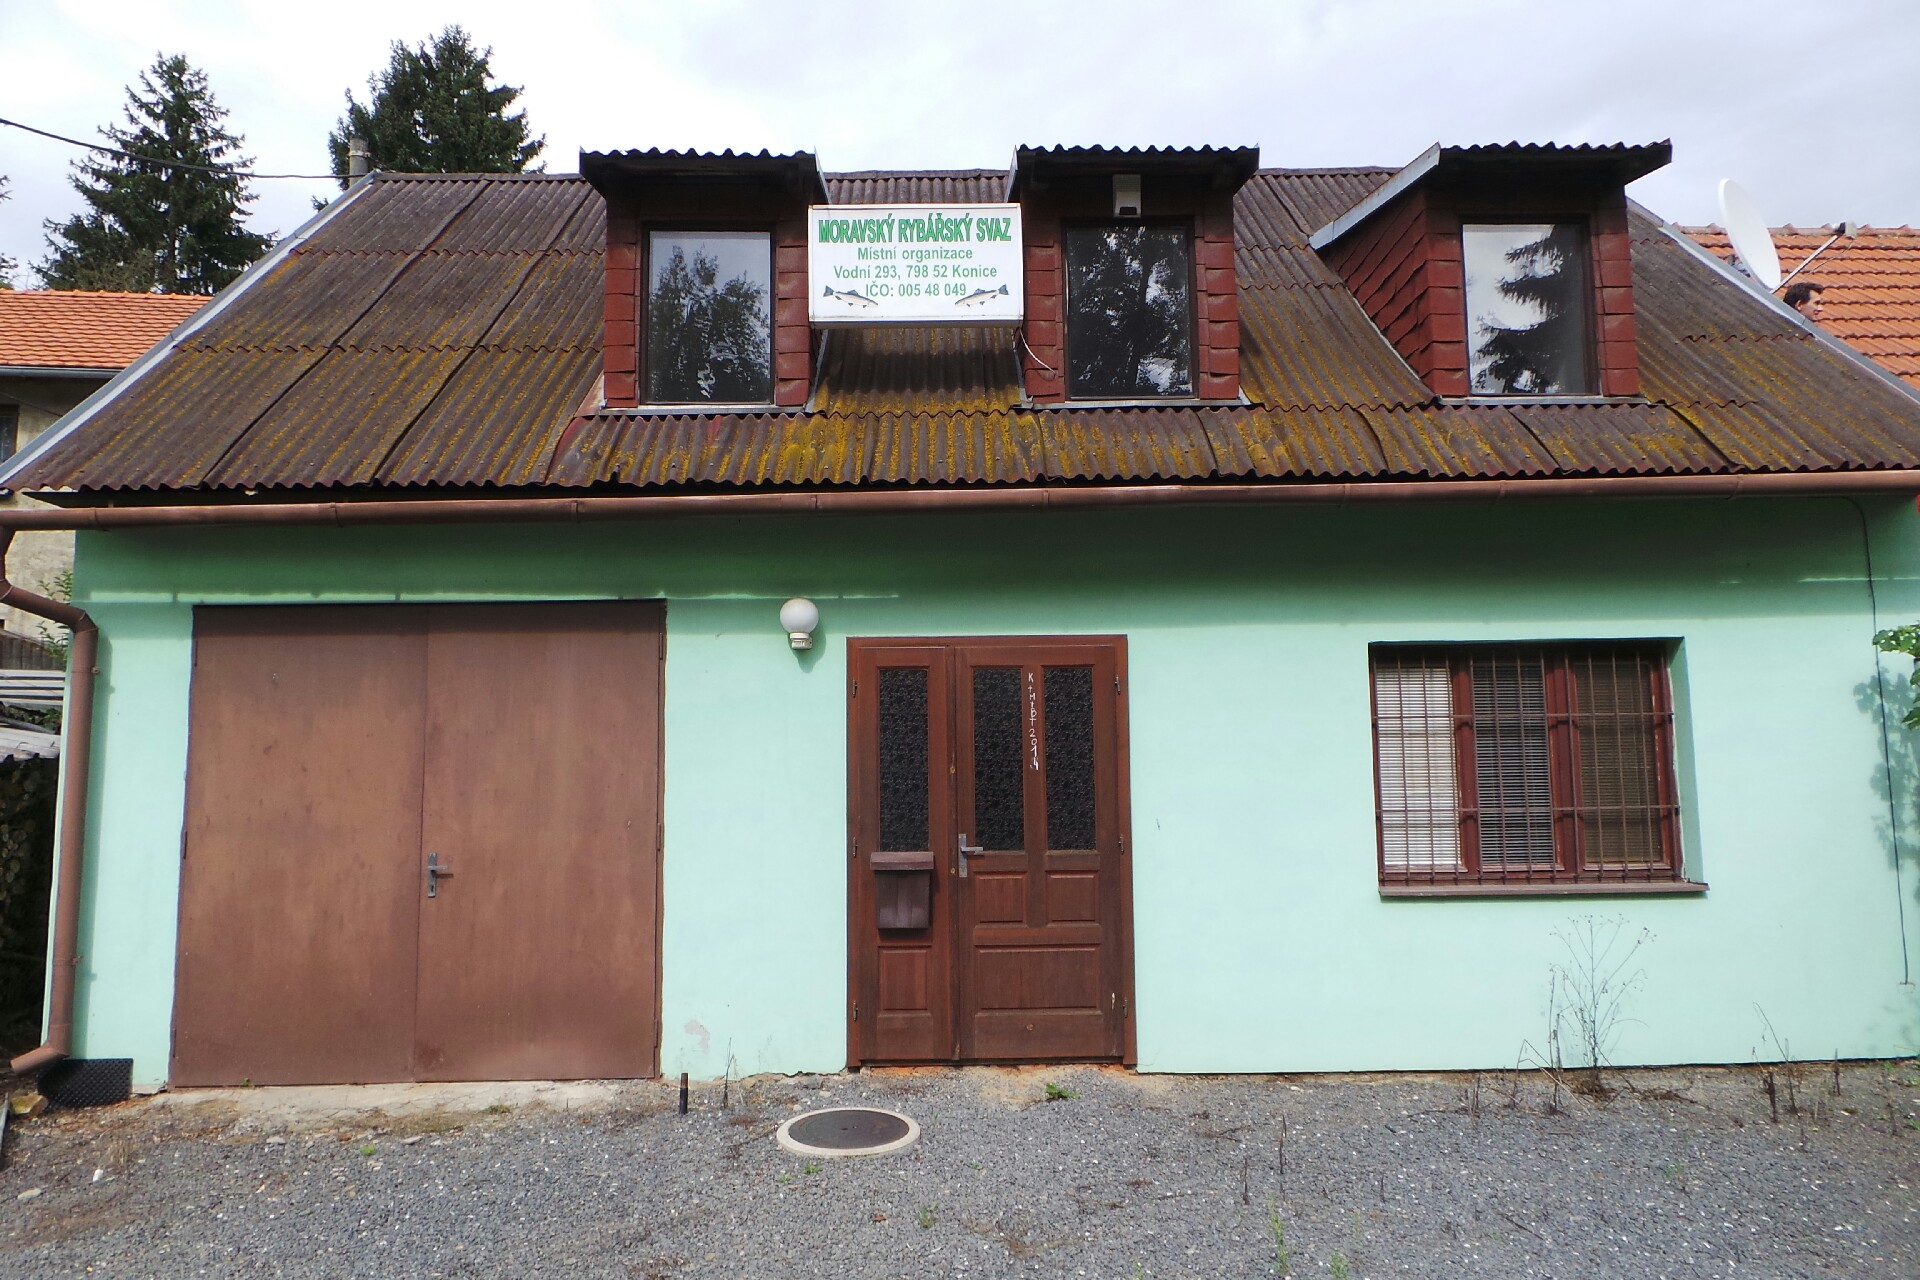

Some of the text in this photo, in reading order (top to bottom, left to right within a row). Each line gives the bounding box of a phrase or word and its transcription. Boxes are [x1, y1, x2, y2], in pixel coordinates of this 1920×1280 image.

[819, 213, 1012, 243] MORAVSKÝ RYBÁŘSKÝ SVAZ
[858, 247, 972, 262] Místní organizace
[834, 264, 997, 280] Vodní 293, 798 52 Konice
[866, 281, 966, 297] IČO: 005 48 049
